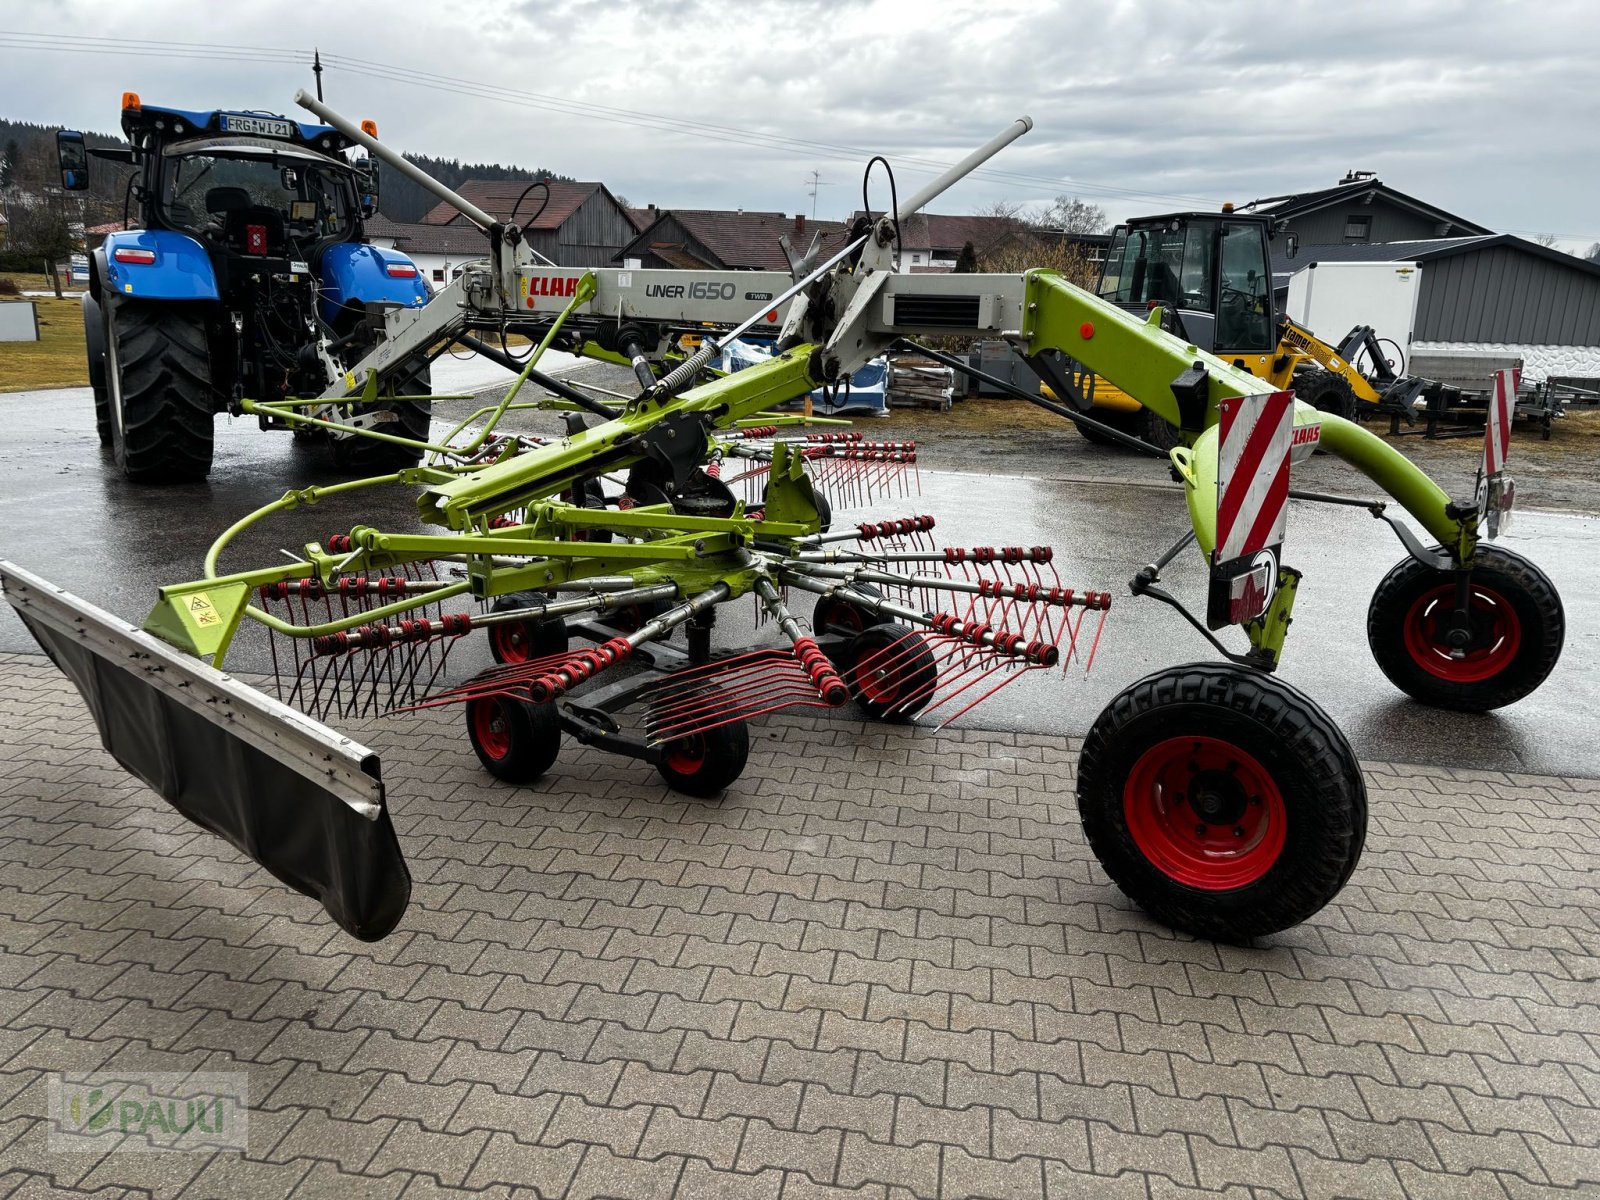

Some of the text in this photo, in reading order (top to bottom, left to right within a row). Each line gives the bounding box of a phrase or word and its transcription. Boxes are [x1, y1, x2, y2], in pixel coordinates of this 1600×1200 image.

[228, 118, 251, 131] FRG
[530, 277, 579, 296] CLAA
[645, 281, 736, 300] LINER 1650
